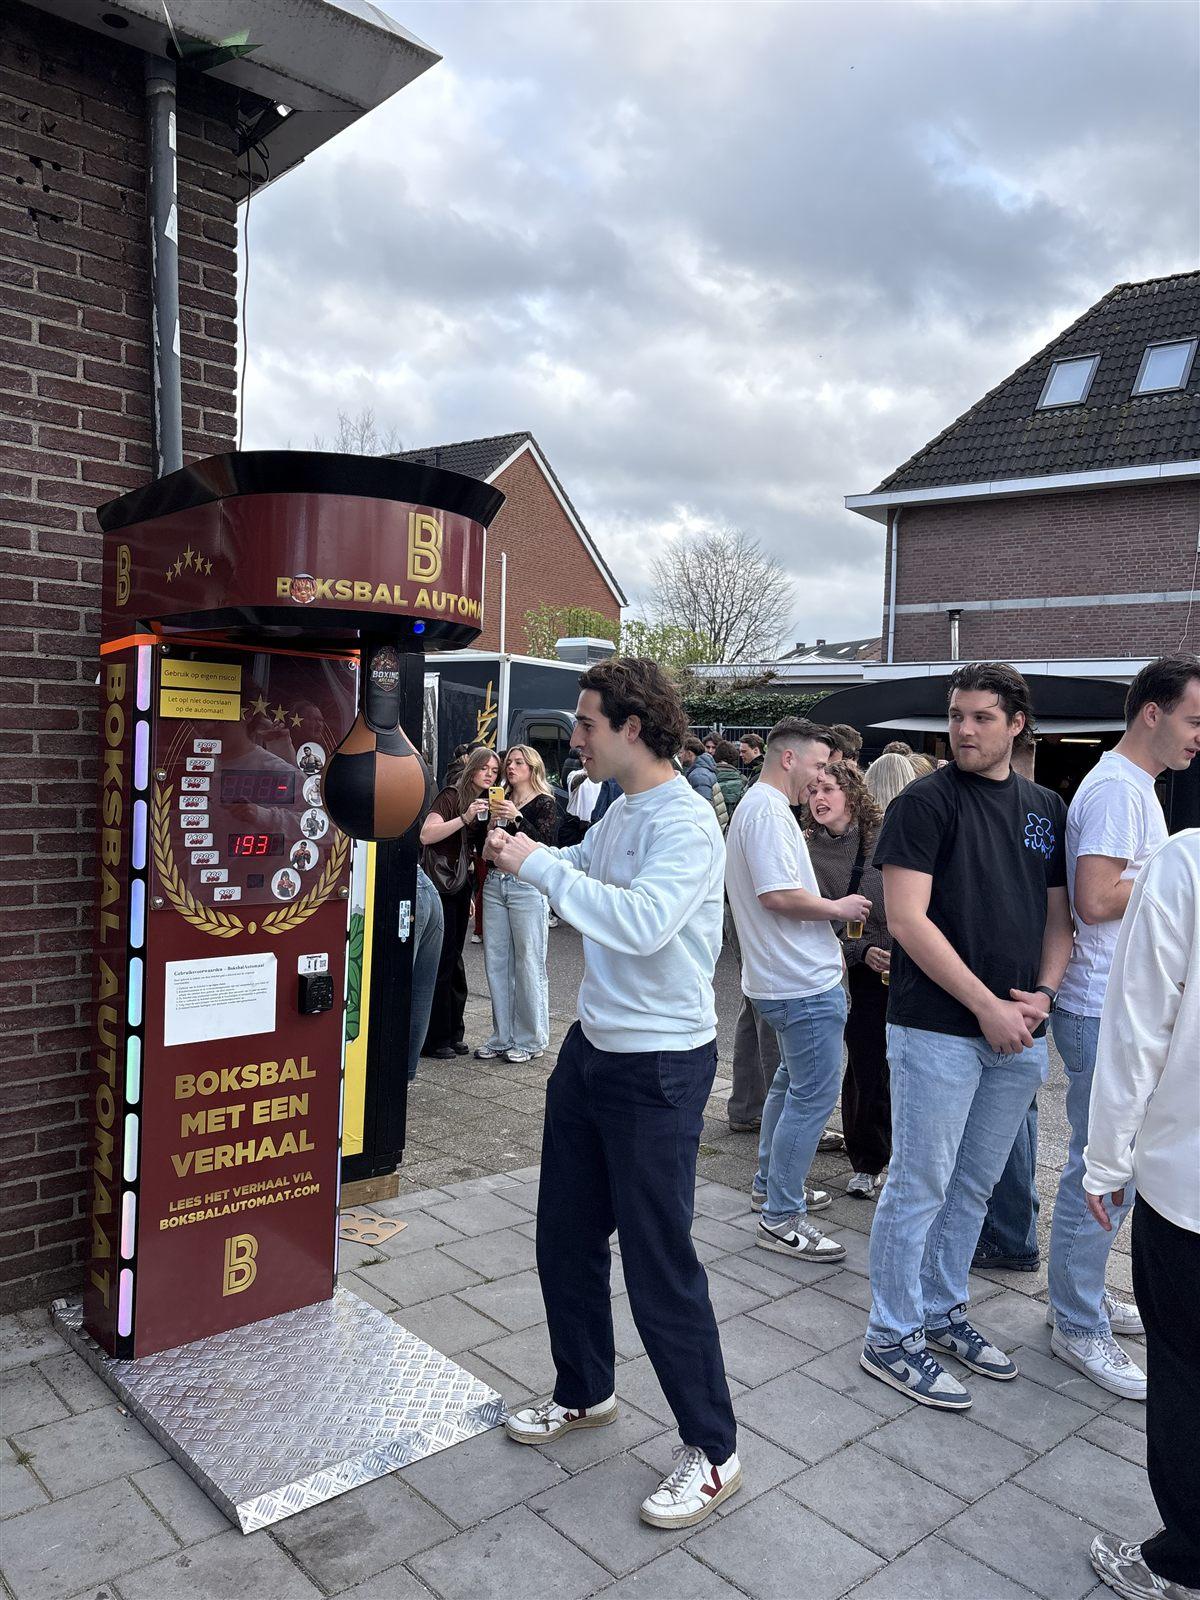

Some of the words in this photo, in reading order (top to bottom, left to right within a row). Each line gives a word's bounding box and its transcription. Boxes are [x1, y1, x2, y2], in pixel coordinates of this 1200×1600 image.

[277, 577, 408, 607] BKSBAL
[164, 669, 189, 678] Gebruik
[200, 673, 218, 681] eigen
[202, 697, 232, 706] doorslaan
[100, 663, 127, 944] BOKSBAL
[235, 835, 268, 855] 193
[175, 1056, 317, 1100] BOKSBAL
[91, 955, 119, 1309] AUTOMAAT
[181, 1104, 246, 1138] MET
[252, 1093, 309, 1125] EEN
[170, 1129, 315, 1178] VERHAAL
[159, 1183, 321, 1231] BOKSBALAUTOMAAT.COM
[169, 1196, 202, 1213] LEES
[204, 1189, 230, 1205] HET
[232, 1177, 291, 1198] VERHAAL
[292, 1171, 313, 1184] VIA
